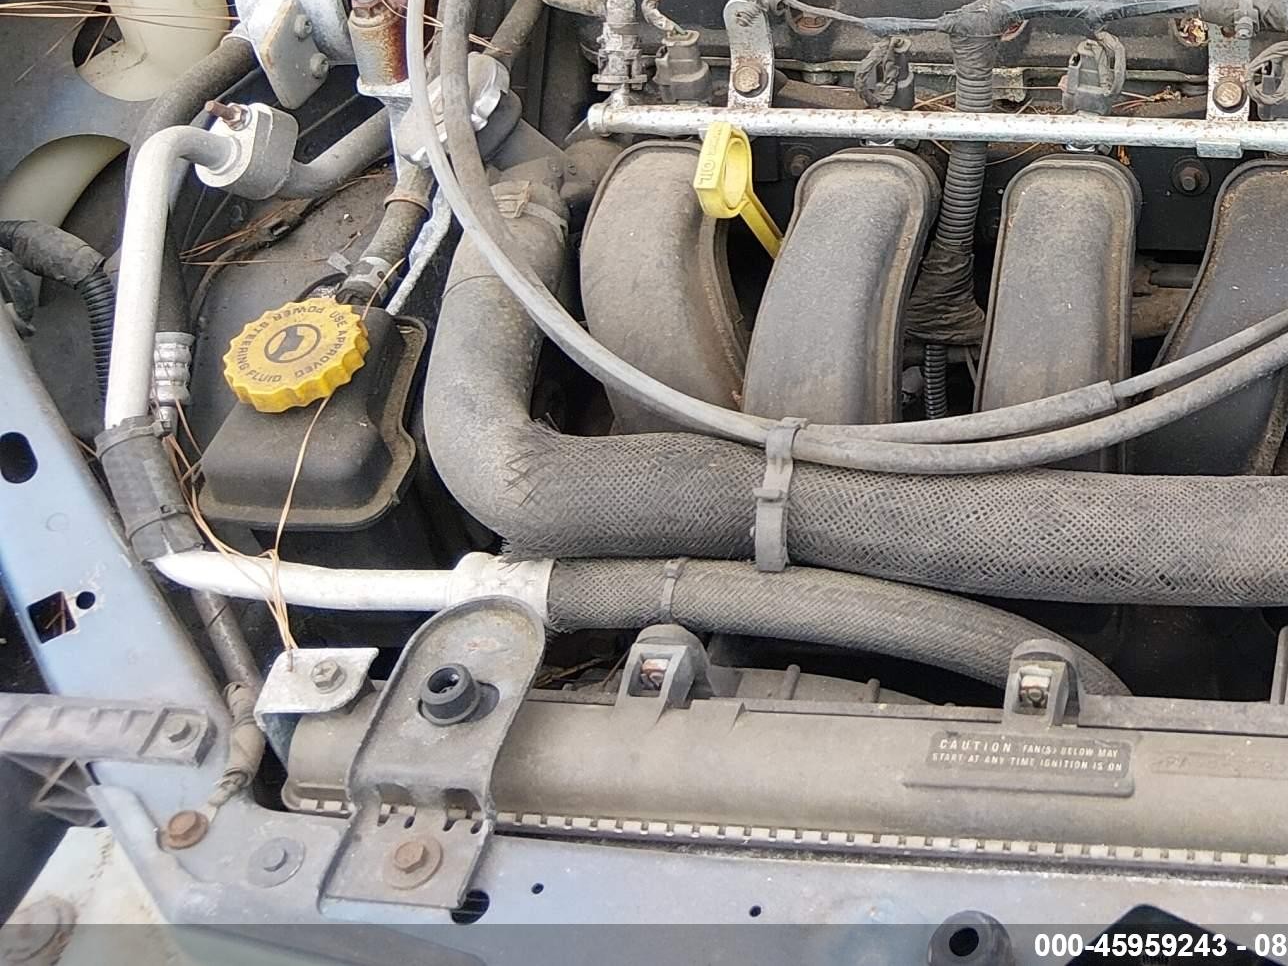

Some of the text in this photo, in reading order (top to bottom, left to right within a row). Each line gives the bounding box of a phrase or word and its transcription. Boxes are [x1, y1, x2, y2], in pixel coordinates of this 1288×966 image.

[237, 305, 326, 383] POWER STEERING FLUID
[294, 311, 348, 379] USE APPROVED
[932, 753, 1123, 772] START AT ANY TIME IGNITION IS ON
[939, 738, 1012, 753] CAUTION
[1060, 747, 1094, 757] BELOW
[1097, 748, 1119, 759] MAY
